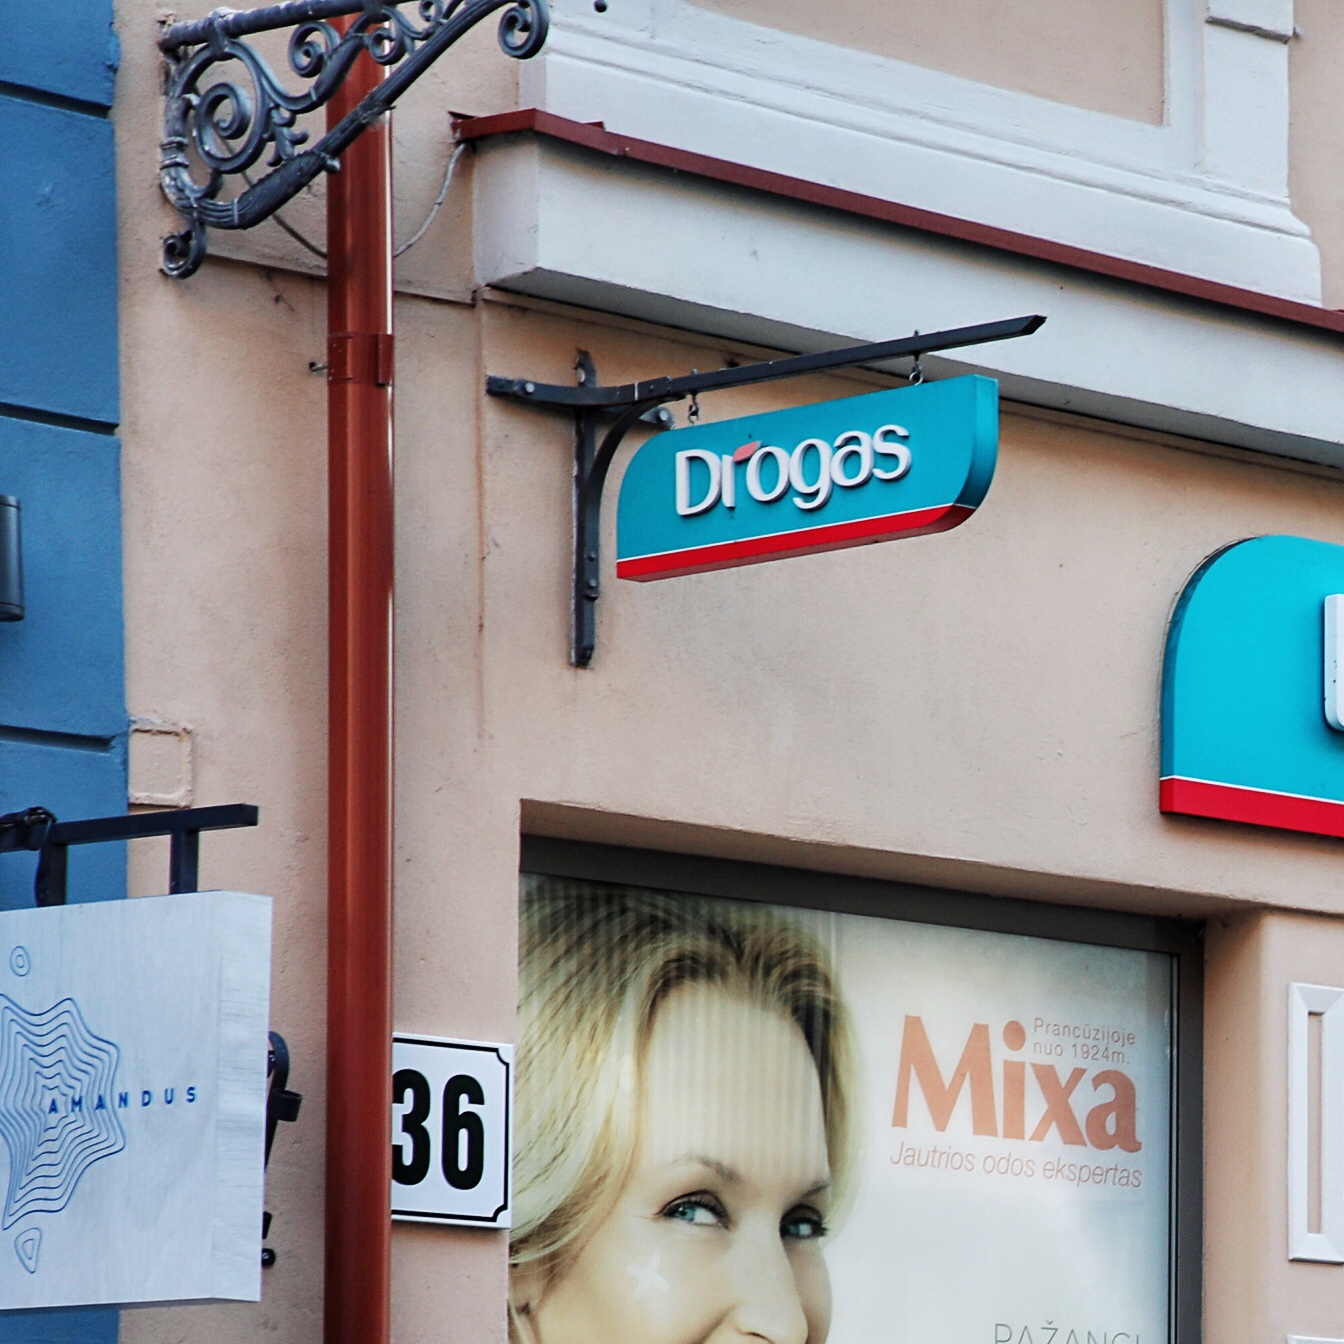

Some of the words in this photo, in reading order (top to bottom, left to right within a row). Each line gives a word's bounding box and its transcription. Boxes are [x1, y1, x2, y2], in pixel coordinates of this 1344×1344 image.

[675, 424, 912, 516] Drogas
[1033, 1039, 1064, 1057] nuo
[48, 1086, 197, 1114] AMANDUS
[891, 1015, 1142, 1153] Mixa
[392, 1068, 485, 1190] 36
[889, 1141, 975, 1171] Jautrios
[982, 1151, 1035, 1178] odos
[1042, 1156, 1142, 1188] ekspertas
